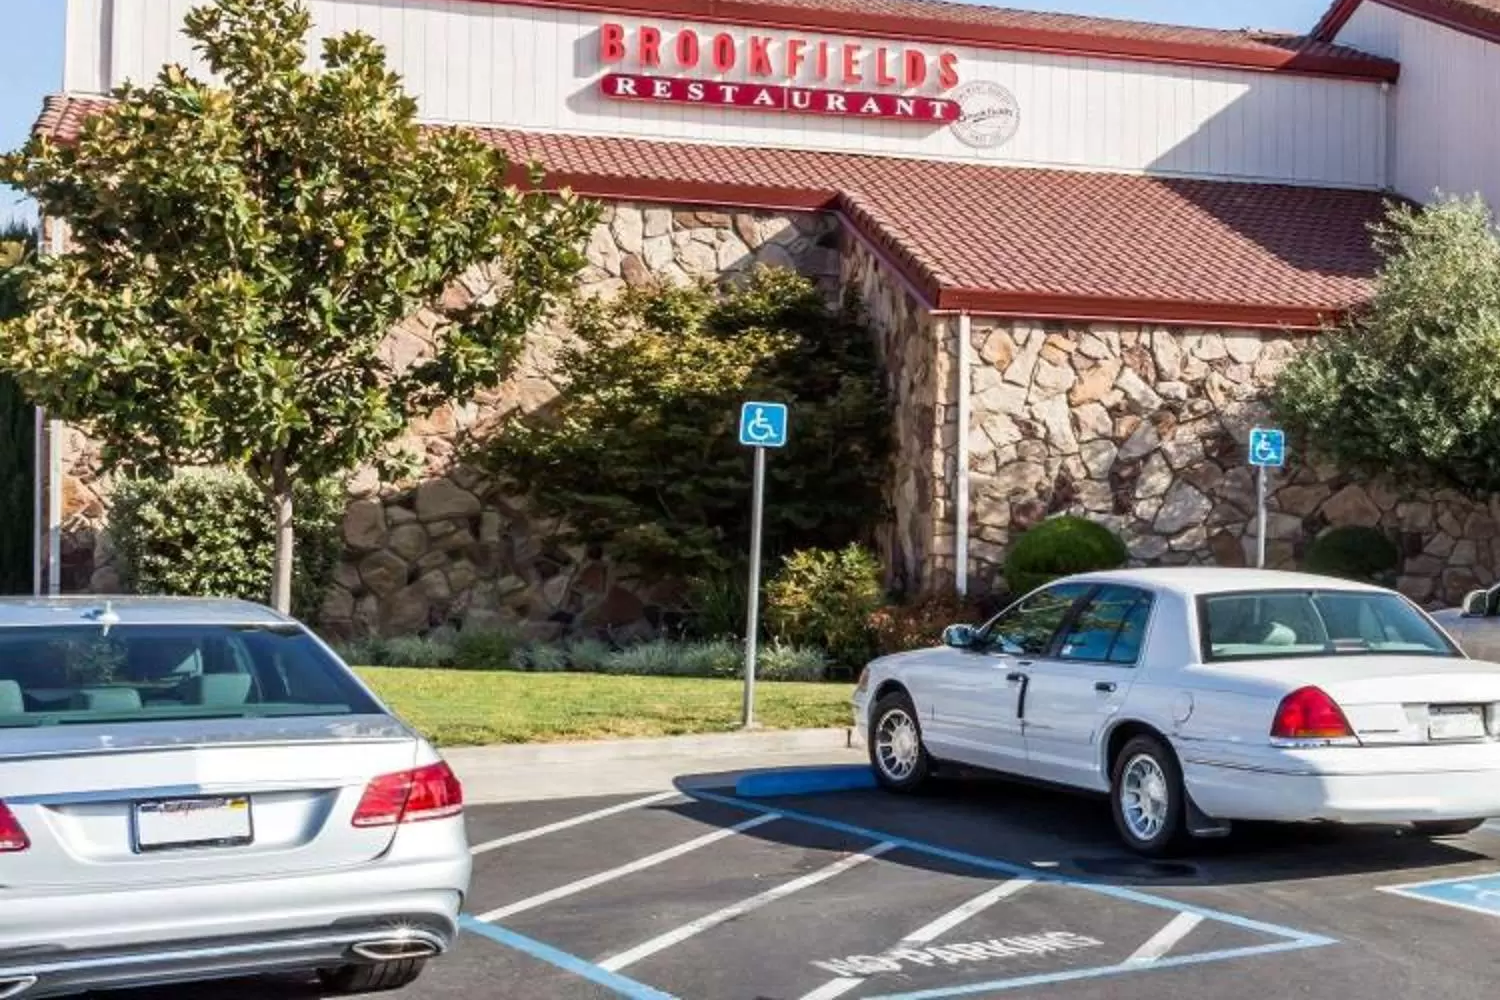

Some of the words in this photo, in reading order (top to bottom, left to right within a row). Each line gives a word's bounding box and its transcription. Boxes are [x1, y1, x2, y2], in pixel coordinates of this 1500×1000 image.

[600, 22, 960, 90] BROOKFIELDS
[613, 76, 949, 121] RESTAURANT
[808, 954, 903, 977] NO
[886, 930, 1105, 967] PARKING
